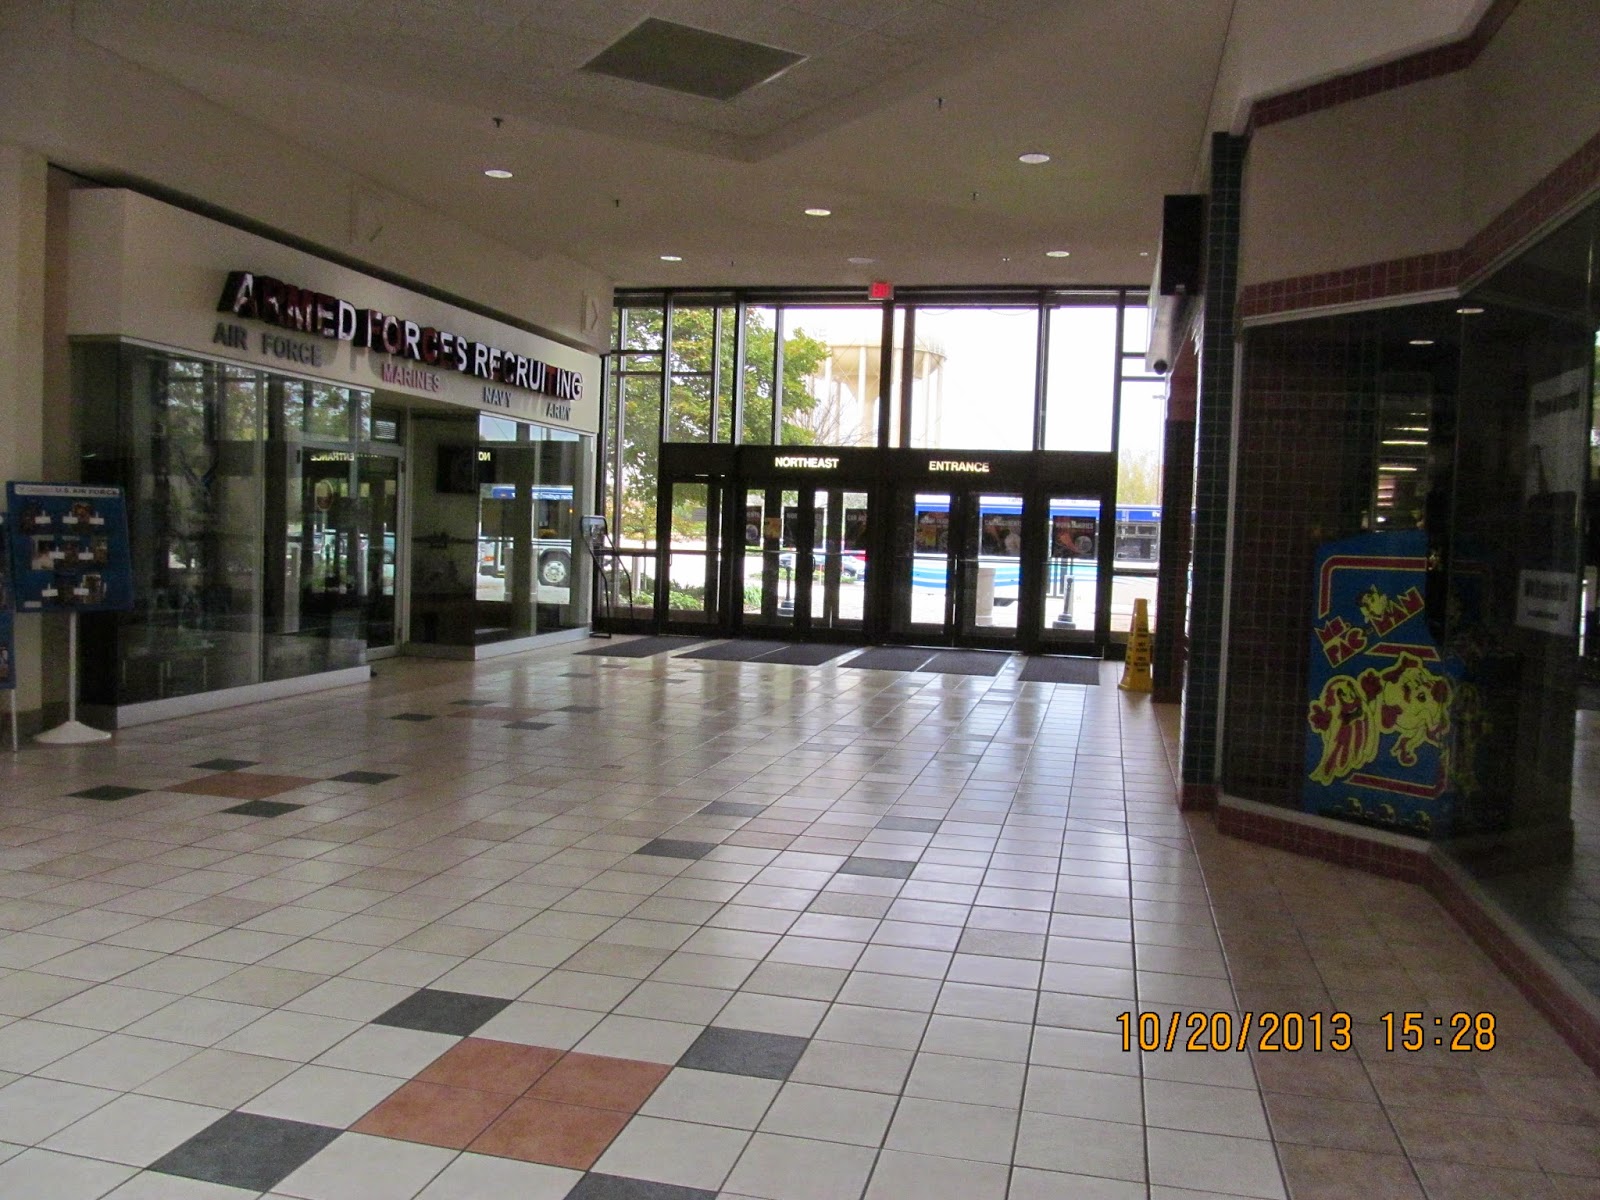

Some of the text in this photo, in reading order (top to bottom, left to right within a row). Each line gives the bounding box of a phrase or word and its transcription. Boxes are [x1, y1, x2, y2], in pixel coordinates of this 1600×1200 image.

[213, 322, 322, 366] AIR FORCE
[219, 271, 583, 400] ARMED FORCES RECRUITING
[382, 363, 441, 393] MARINES
[483, 386, 512, 408] NAVY
[546, 402, 571, 421] ARMY
[774, 456, 991, 473] NORTHEAST ENTRANCE
